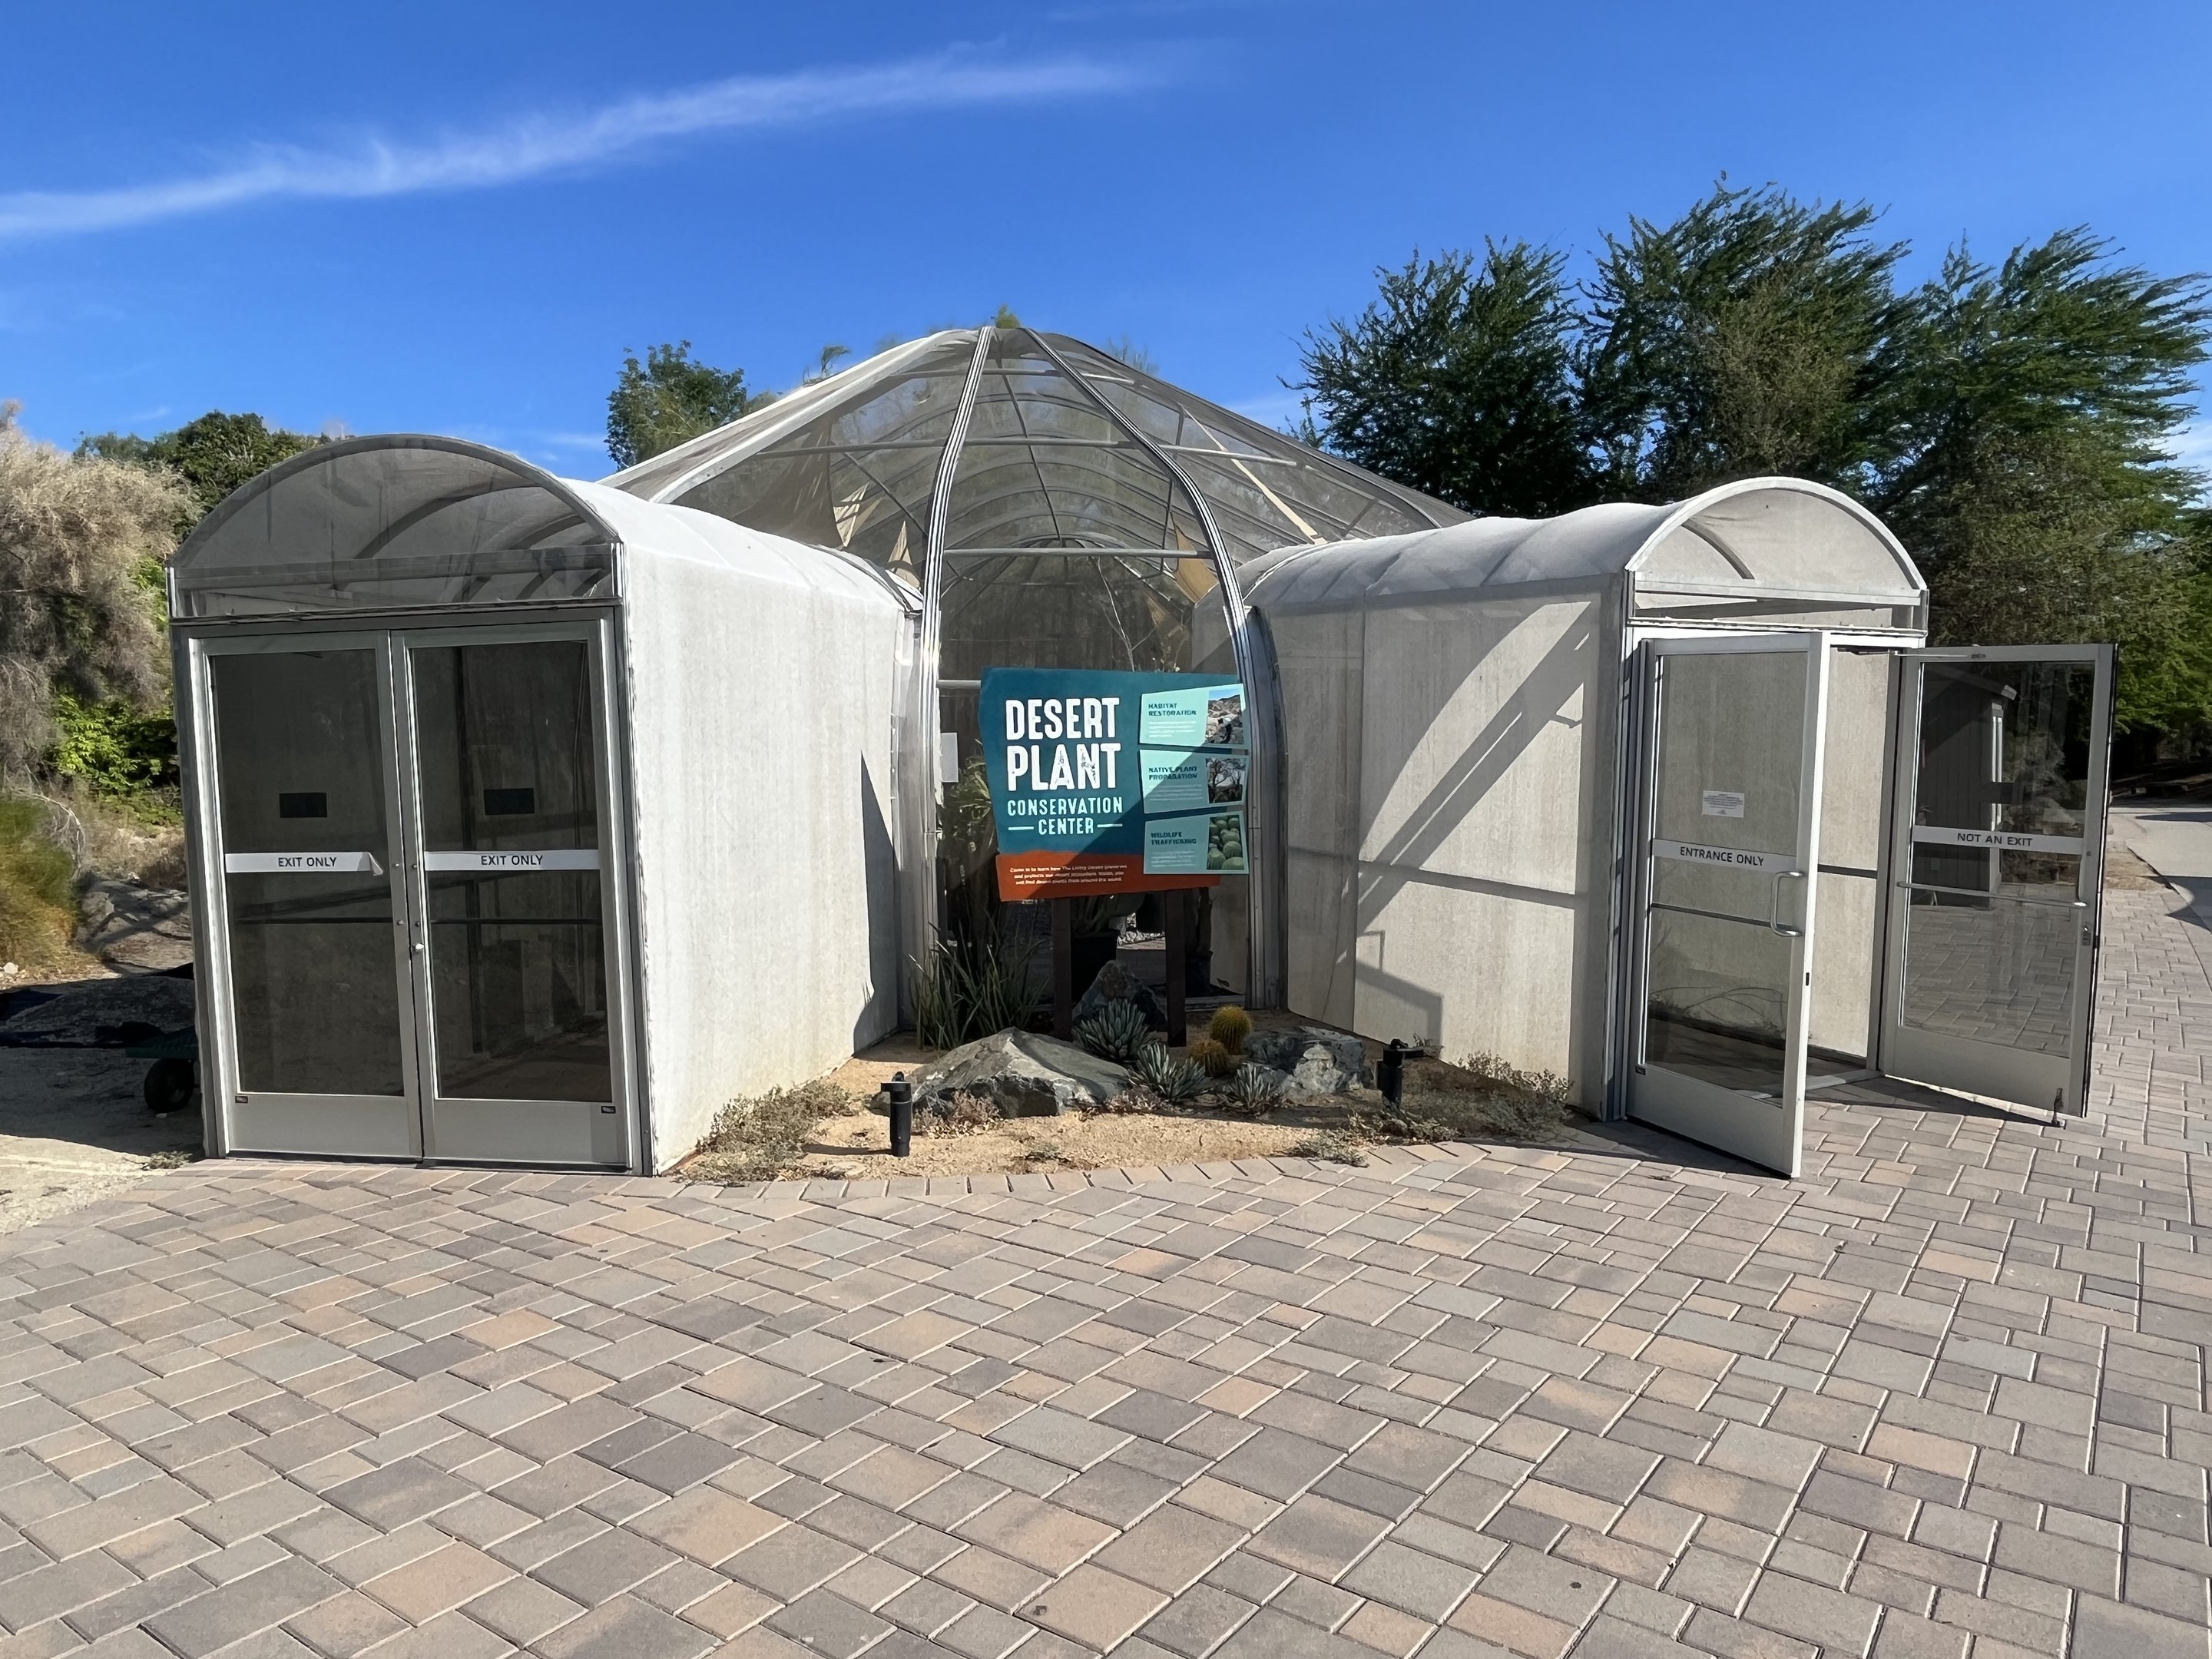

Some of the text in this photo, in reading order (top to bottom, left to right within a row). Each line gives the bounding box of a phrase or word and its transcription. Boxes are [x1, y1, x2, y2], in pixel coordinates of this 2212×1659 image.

[1005, 697, 1120, 740] DESERT
[1007, 743, 1121, 791] PLANT
[1007, 796, 1123, 816] CONSERVATION
[1038, 817, 1094, 835] CENTER
[1957, 833, 2034, 846] NOT AN EXIT
[278, 856, 337, 867] EXIT ONLY
[481, 855, 543, 866] EXIT ONLY
[1680, 846, 1764, 866] ENTRANCE ONLY
